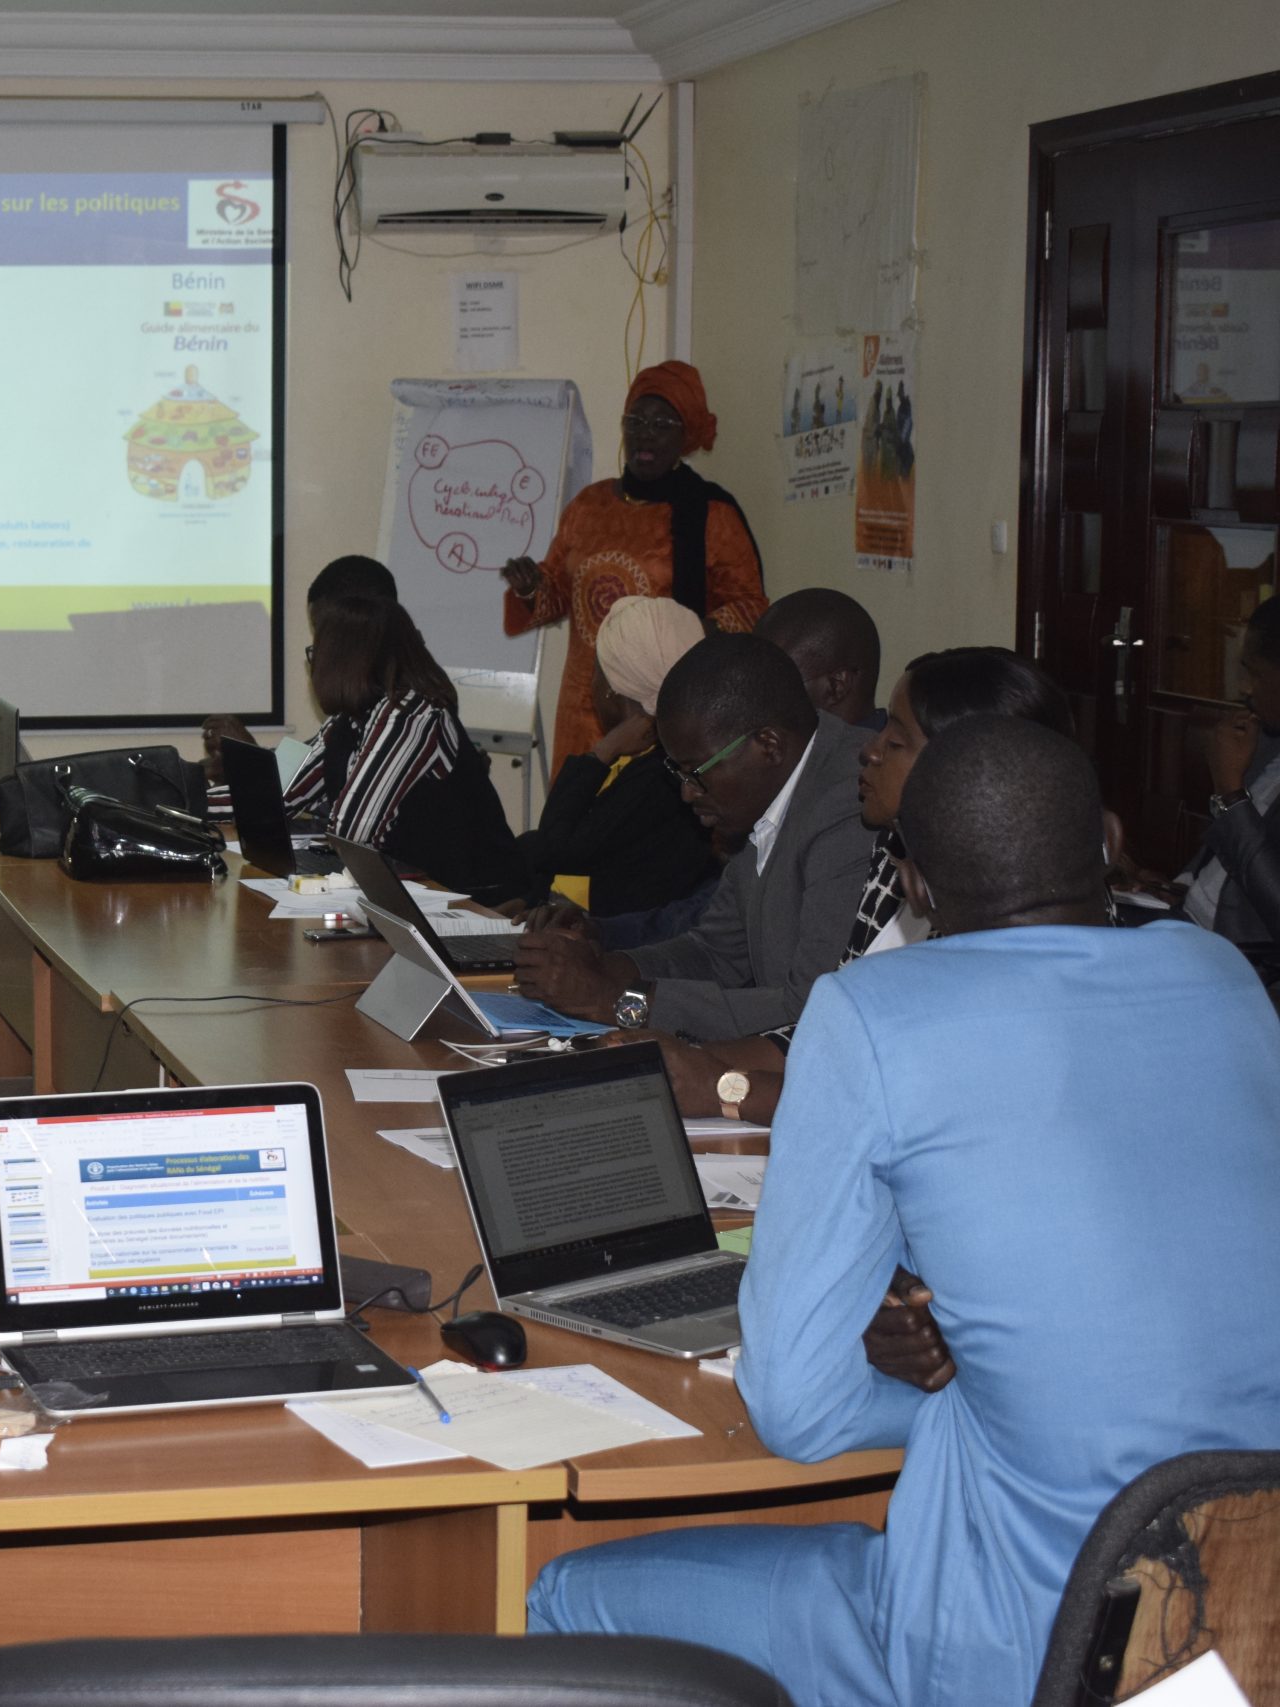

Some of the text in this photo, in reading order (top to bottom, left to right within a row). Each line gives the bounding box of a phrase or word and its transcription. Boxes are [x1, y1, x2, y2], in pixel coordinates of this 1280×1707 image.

[1, 197, 34, 213] sur
[40, 192, 68, 212] les
[75, 192, 180, 217] politiques
[171, 271, 225, 290] Bénin
[141, 321, 175, 334] Guide
[173, 334, 228, 351] Bénin
